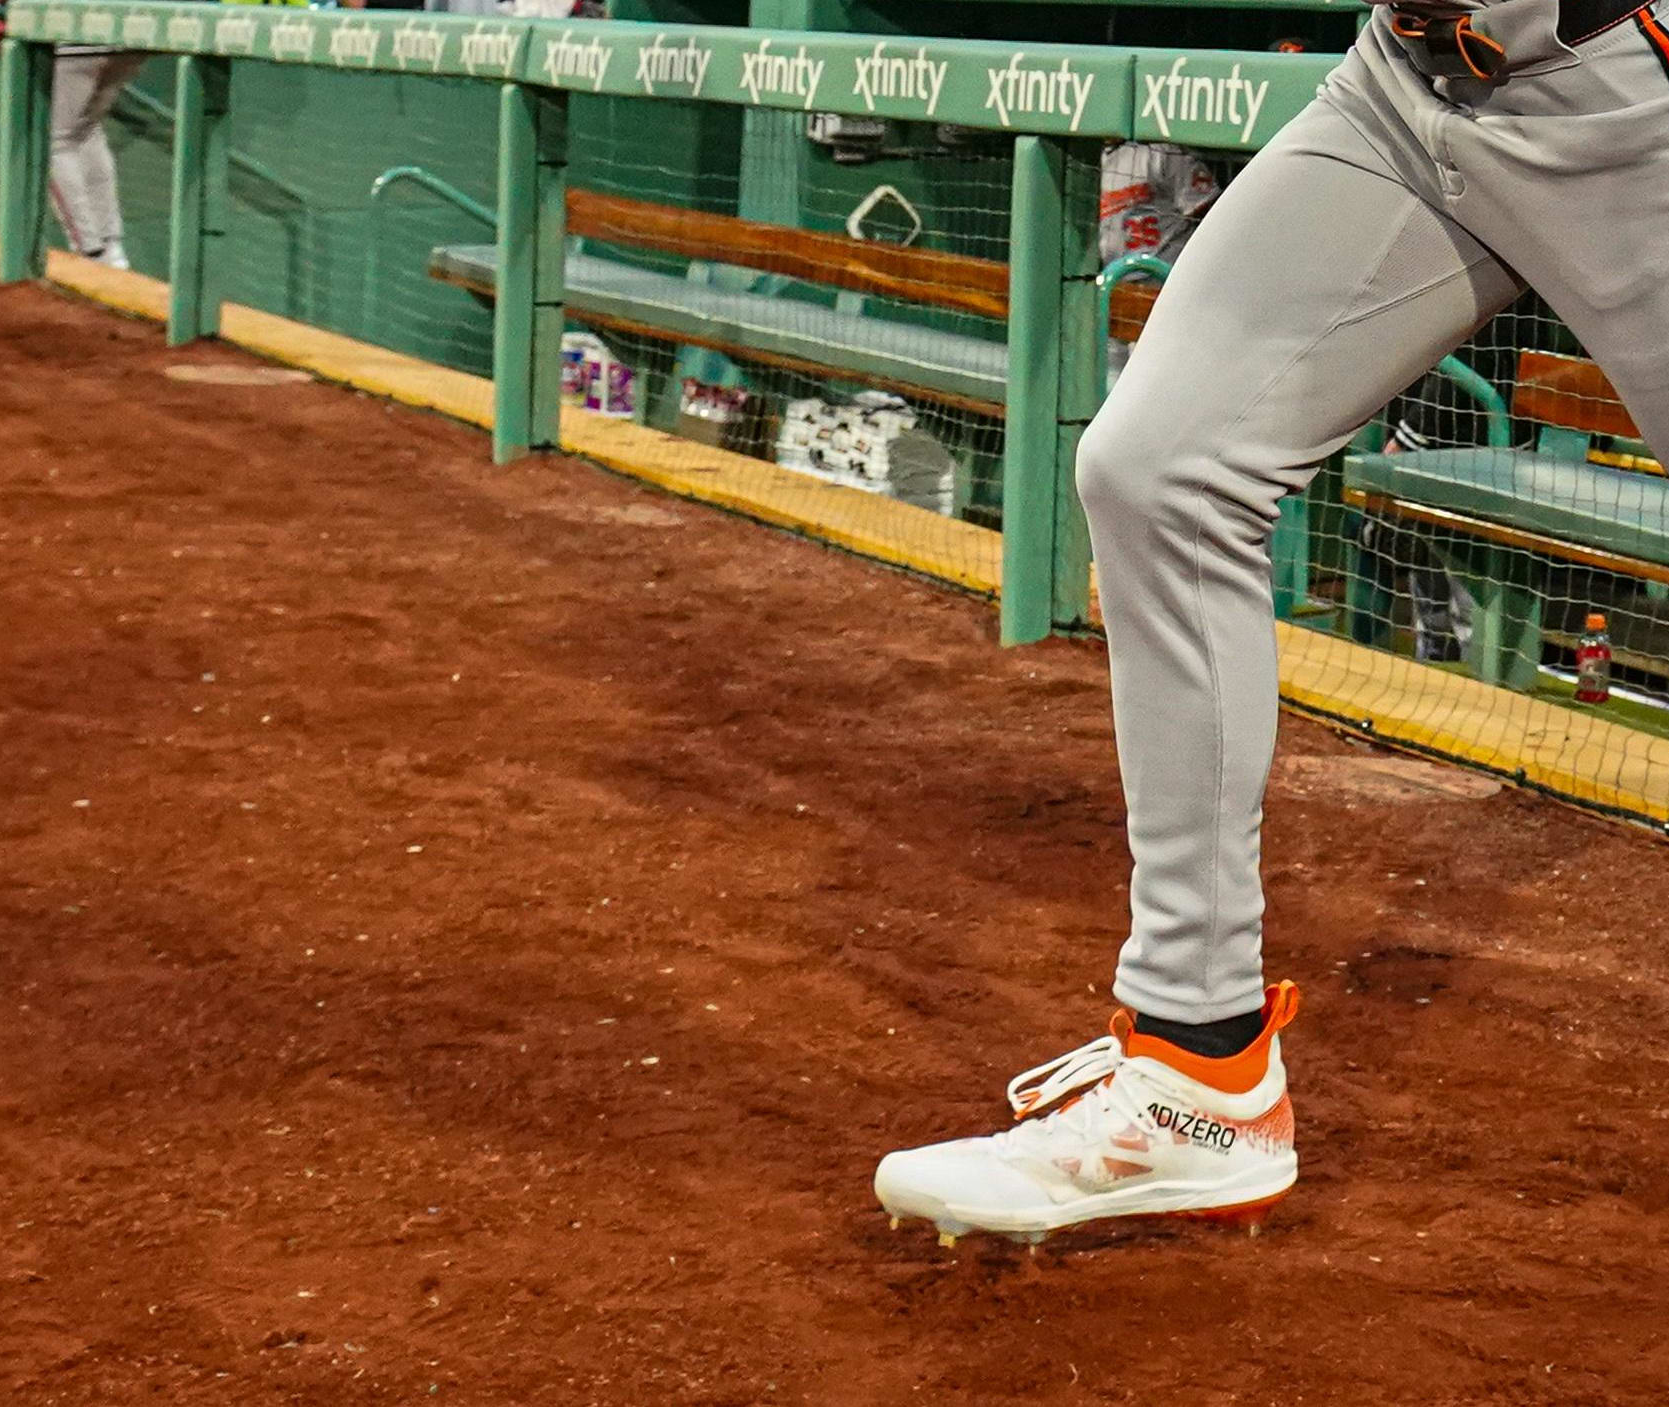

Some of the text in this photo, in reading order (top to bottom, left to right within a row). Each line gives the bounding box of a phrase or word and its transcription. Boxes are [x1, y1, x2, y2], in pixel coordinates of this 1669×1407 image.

[543, 28, 613, 92] xfinity
[635, 32, 712, 96] xfinity
[740, 37, 824, 110] xfinity
[852, 41, 949, 116] xfinity
[984, 51, 1095, 132] xfinity
[1141, 56, 1270, 143] xfinity
